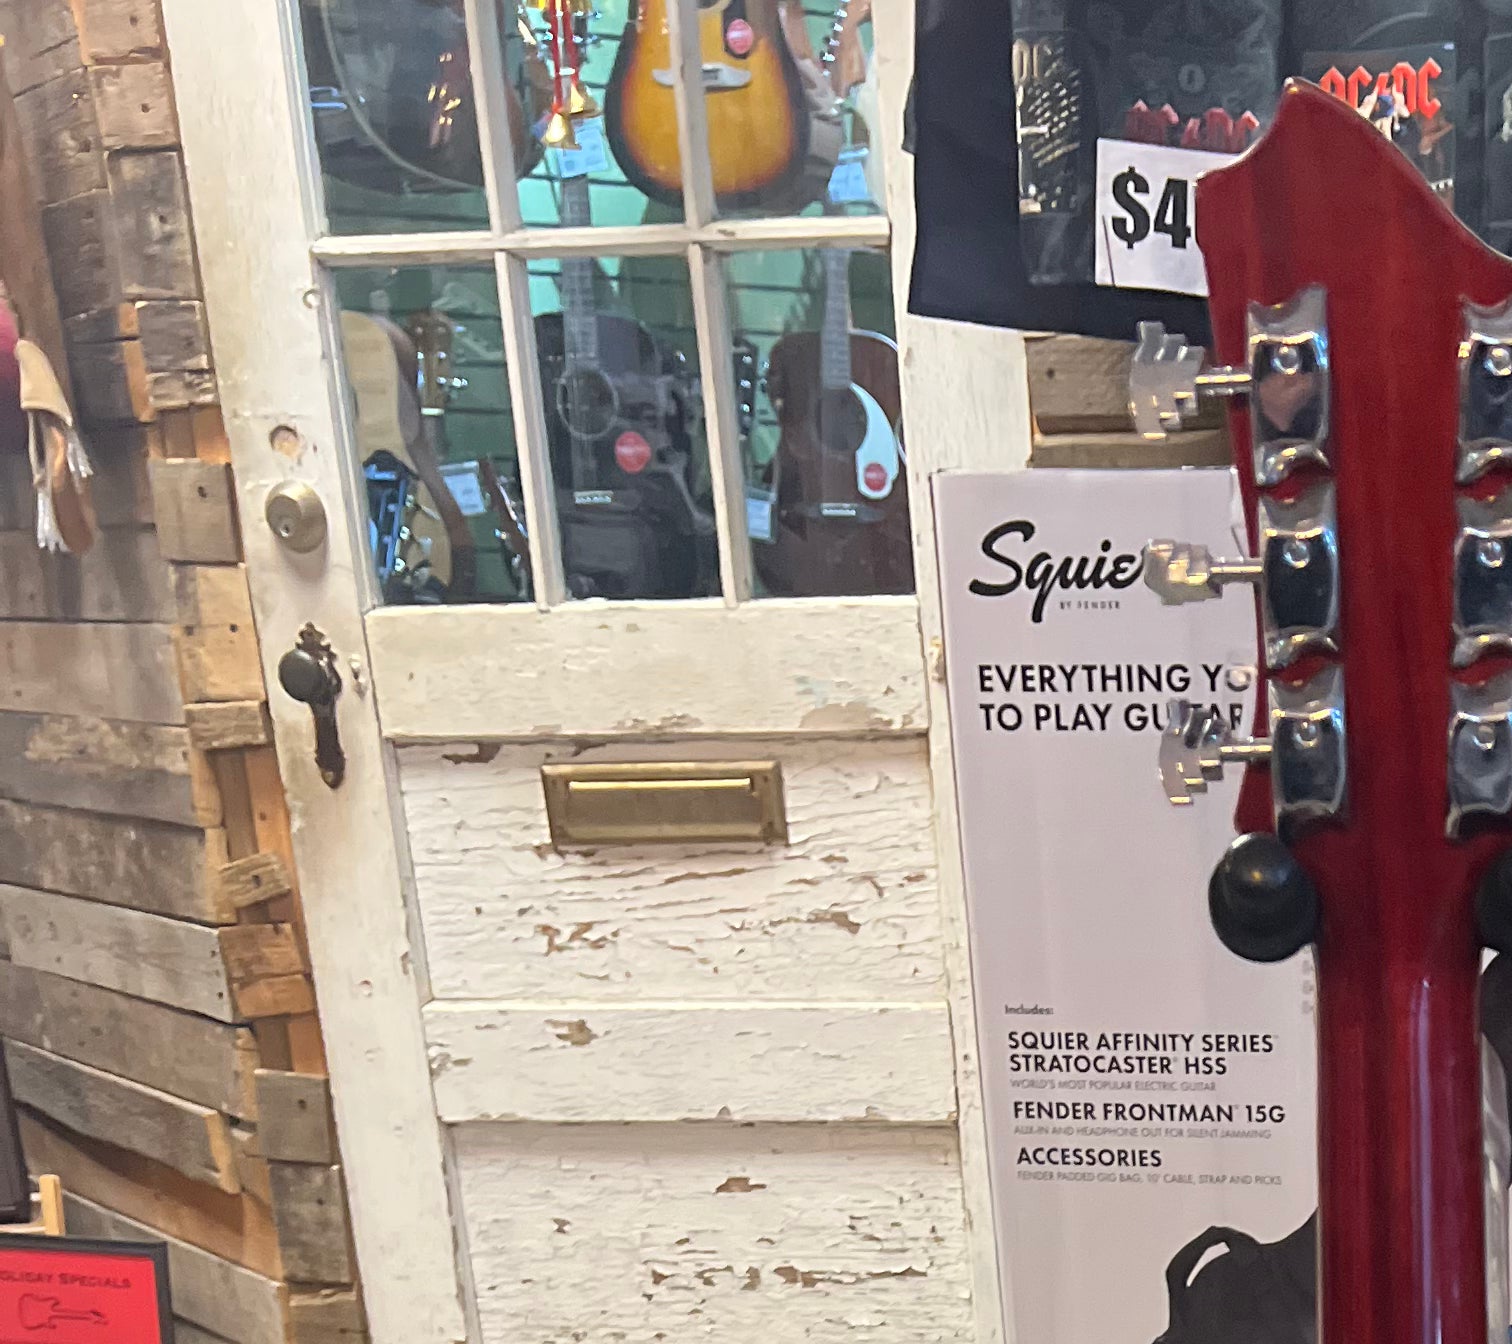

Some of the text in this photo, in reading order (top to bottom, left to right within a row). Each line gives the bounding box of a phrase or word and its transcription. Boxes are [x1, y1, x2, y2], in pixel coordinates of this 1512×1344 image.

[1111, 165, 1192, 250] $4
[969, 519, 1146, 623] Squie
[978, 664, 1190, 692] EVERYTHING
[980, 703, 1022, 730] TO
[1034, 703, 1112, 731] PLAY
[1008, 1031, 1274, 1053] SQUIER AFFINITY SERIES
[1009, 1054, 1228, 1076] STRATOCASTER HSS
[1013, 1102, 1286, 1123] FENDER FRONTMAN 15G
[1017, 1147, 1162, 1168] ACCESSORIES
